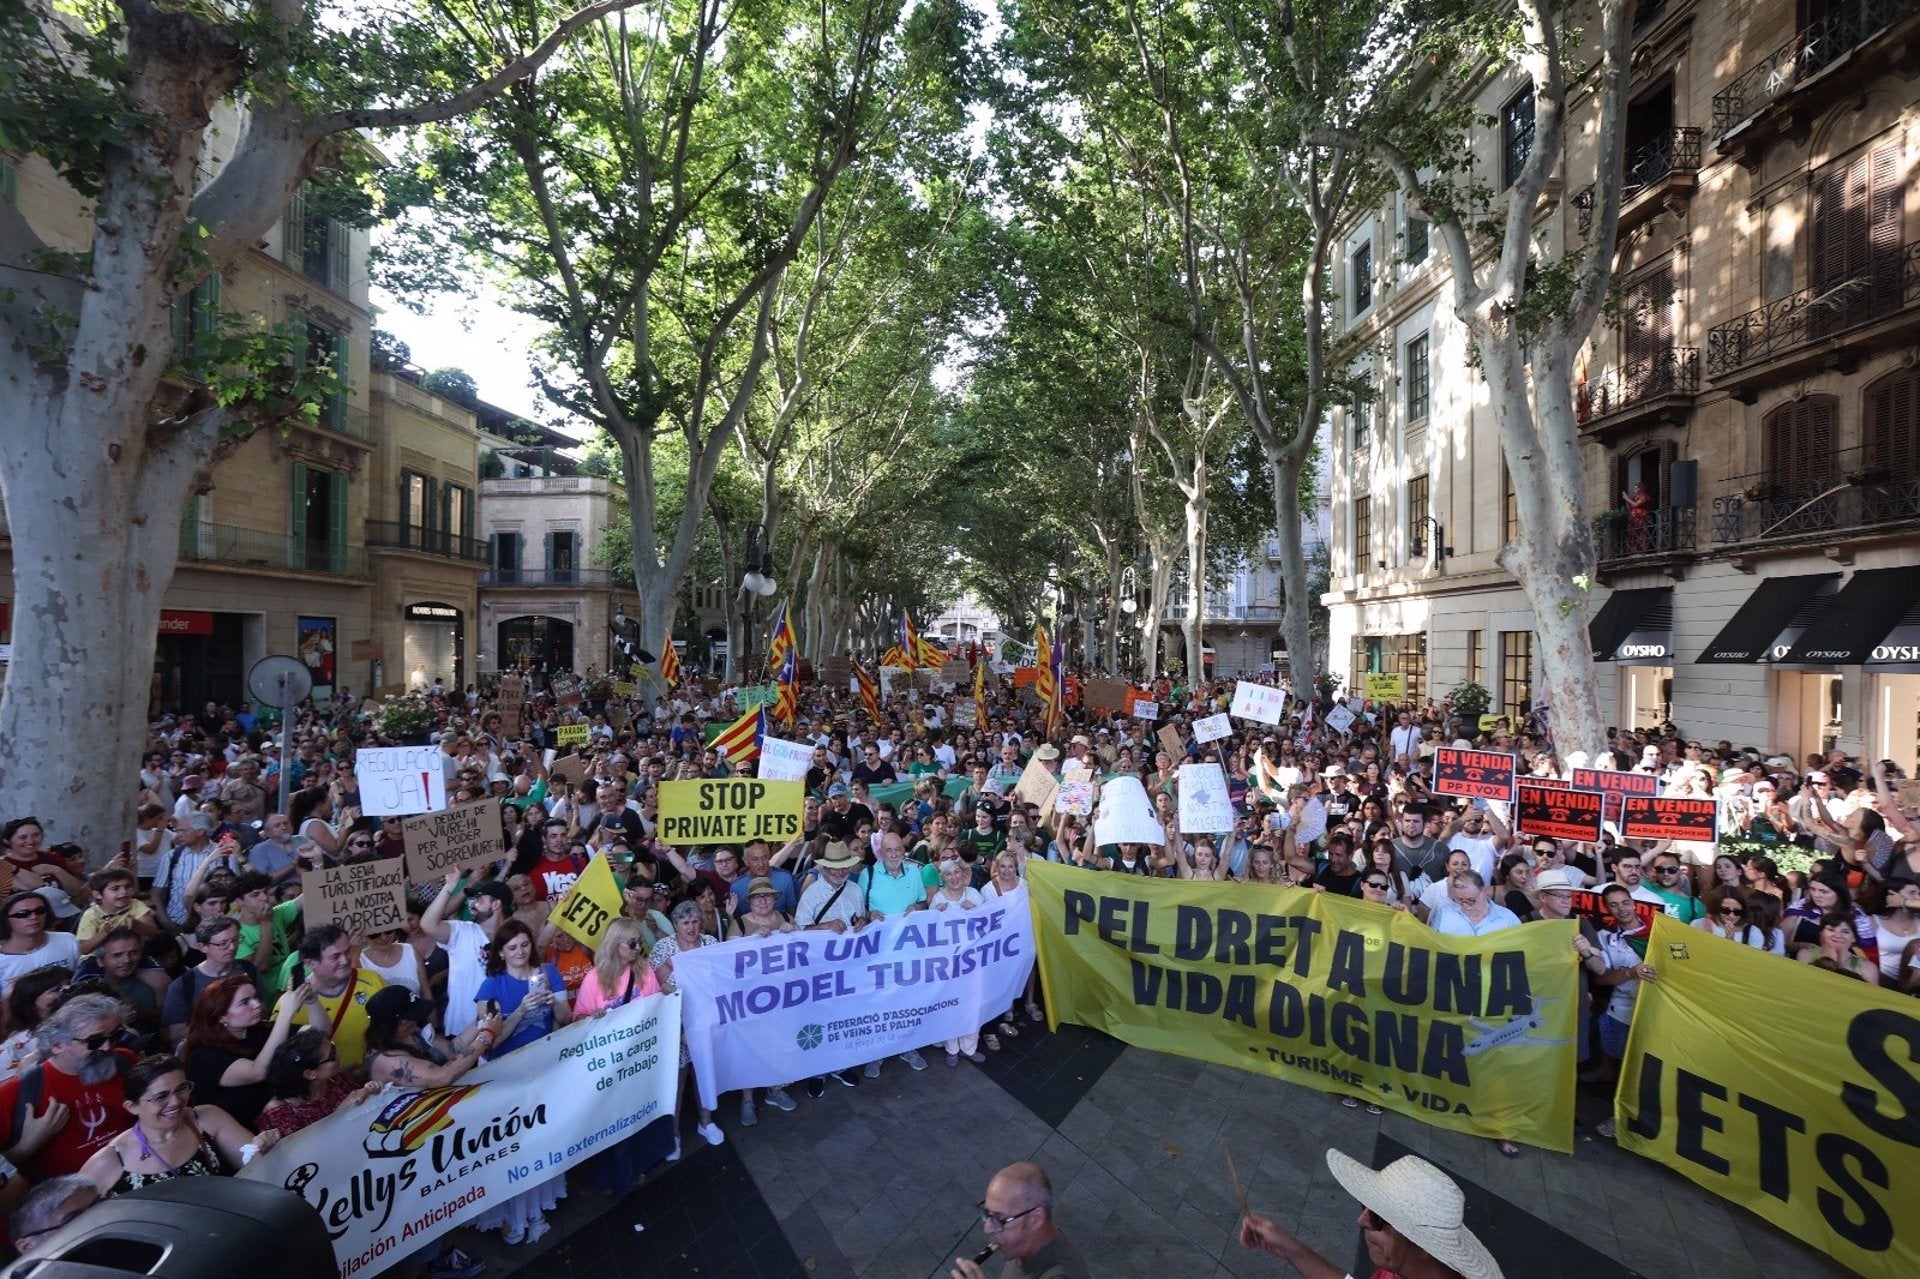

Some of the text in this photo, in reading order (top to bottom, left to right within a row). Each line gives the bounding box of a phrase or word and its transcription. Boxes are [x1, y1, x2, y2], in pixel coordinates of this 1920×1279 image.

[1622, 644, 1665, 657] OYSHO
[1806, 650, 1851, 658] OYSHO
[1439, 750, 1512, 771] EN VENDA
[700, 782, 766, 810] STOP
[1447, 782, 1502, 797] PP I VOX
[1575, 770, 1595, 786] EN
[1599, 772, 1655, 794] VENDA
[1522, 788, 1600, 811] EN VENDA
[1627, 798, 1715, 814] EN VENDA
[406, 804, 487, 832] HEM DEIXAT DE
[429, 818, 477, 838] VIURE-HI
[663, 814, 798, 838] PRIVATE JETS
[418, 828, 481, 855] PER PODER
[326, 864, 375, 883] LA SEVA
[333, 891, 395, 914] LA NOSTRA
[561, 892, 608, 937] JETS
[1572, 892, 1593, 910] EN
[734, 909, 1006, 979] PER UN ALTRE
[1064, 889, 1533, 1017] PEL DRET A UNA
[715, 933, 1021, 1025] MODEL TURÍSTIC
[827, 1013, 880, 1032] FEDERACIÓ
[828, 1032, 840, 1043] DE
[875, 1024, 887, 1033] DE
[890, 1018, 921, 1031] PALMA
[1130, 957, 1471, 1087] VIDA DIGNA
[559, 1016, 657, 1061] Regularización
[587, 1034, 657, 1072] de la carga
[596, 1054, 658, 1091] de Trabajo
[1265, 1047, 1364, 1089] TURISME
[1401, 1084, 1473, 1116] VIDA
[432, 1104, 547, 1174] Unión
[507, 1100, 658, 1184] No a la externalización
[1627, 1051, 1894, 1252] JETS
[420, 1142, 521, 1198] BALEARES
[402, 1183, 486, 1242] Anticipada
